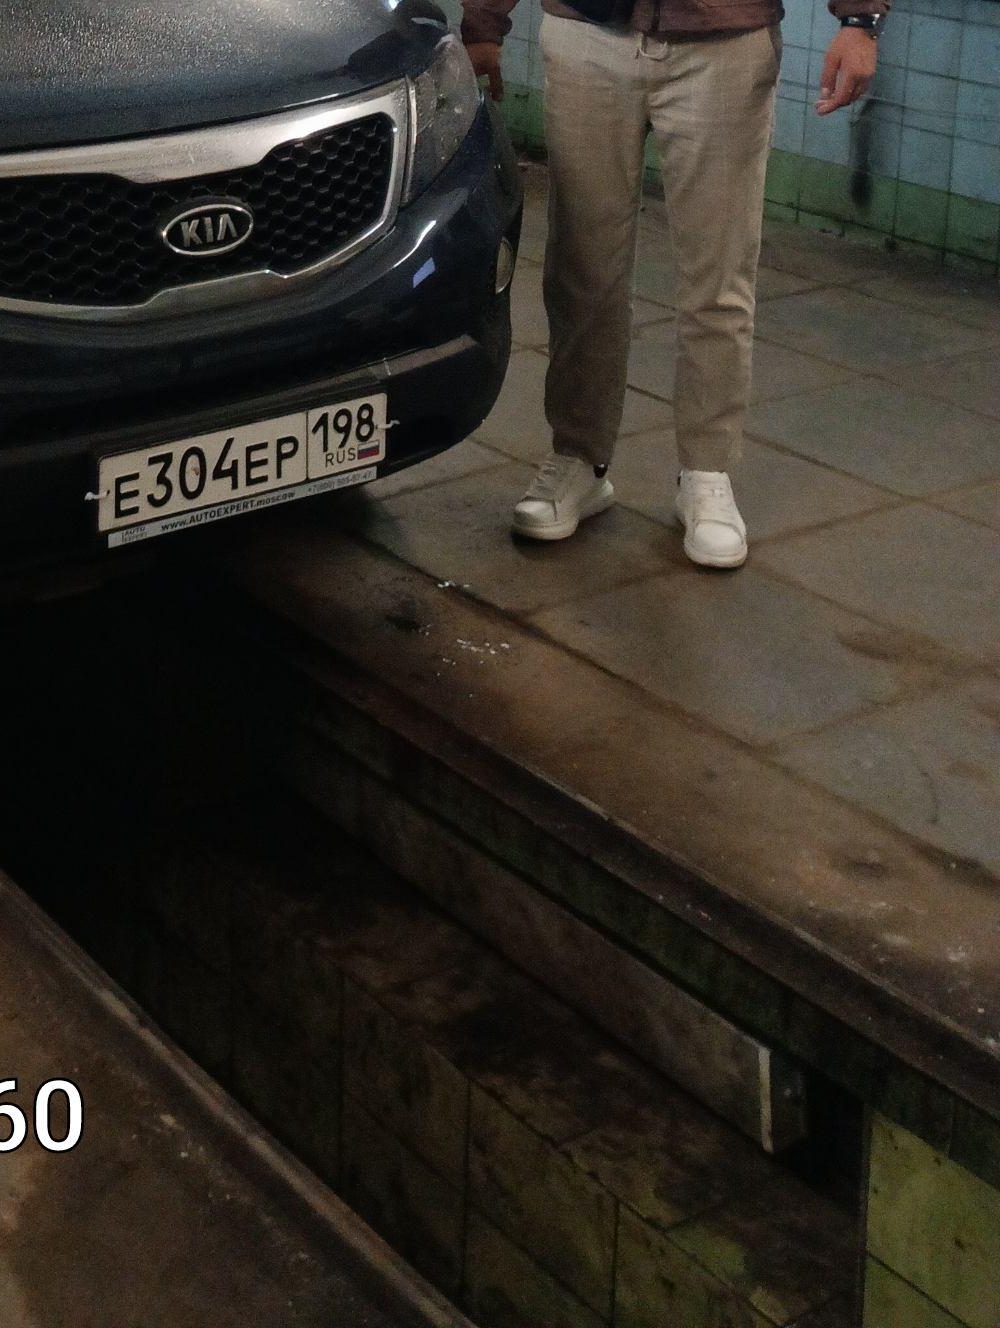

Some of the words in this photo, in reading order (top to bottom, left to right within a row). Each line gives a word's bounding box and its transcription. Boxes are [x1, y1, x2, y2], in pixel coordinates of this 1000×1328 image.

[180, 213, 239, 248] KIA
[311, 403, 376, 452] 198
[324, 446, 357, 468] RUS
